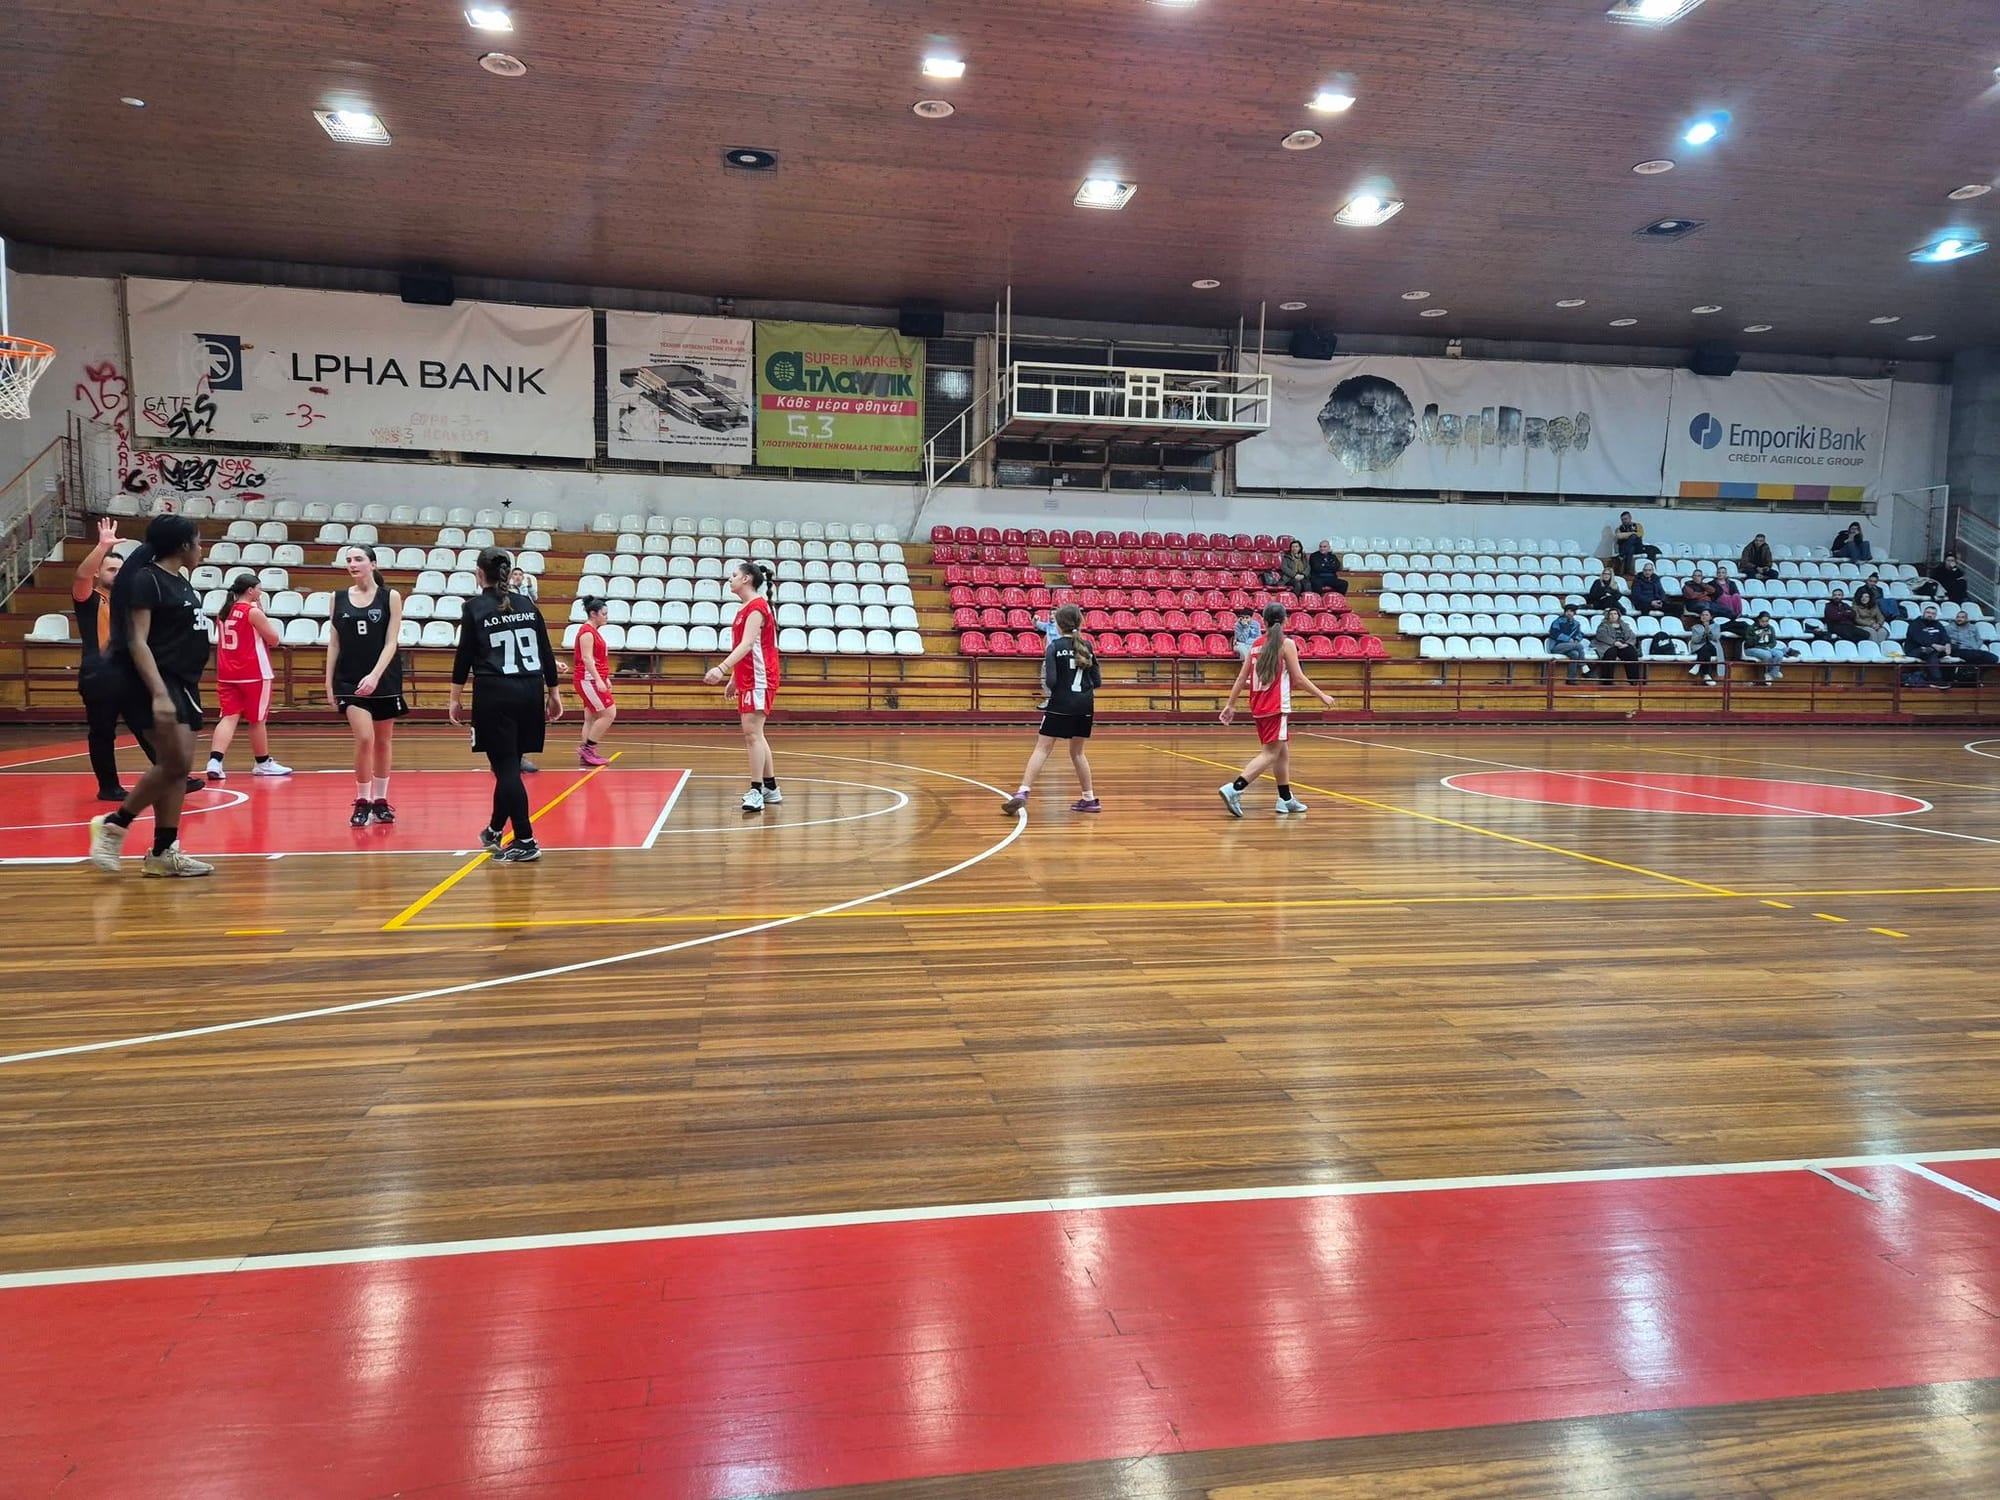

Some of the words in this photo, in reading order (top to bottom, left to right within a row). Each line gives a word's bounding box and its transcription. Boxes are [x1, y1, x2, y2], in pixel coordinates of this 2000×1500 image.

[805, 352, 848, 365] SUPER
[852, 354, 913, 368] MARKETS
[419, 360, 547, 395] BANK
[777, 396, 811, 409] Κάθε
[816, 399, 850, 412] μέρα
[855, 400, 904, 414] φθηνά!
[1729, 424, 1816, 453] Emporiki
[1819, 426, 1867, 451] Bank
[1728, 454, 1768, 463] CREDIT
[1770, 455, 1825, 465] AGRICOLE
[1826, 457, 1864, 466] GROUP
[489, 627, 541, 675] 79
